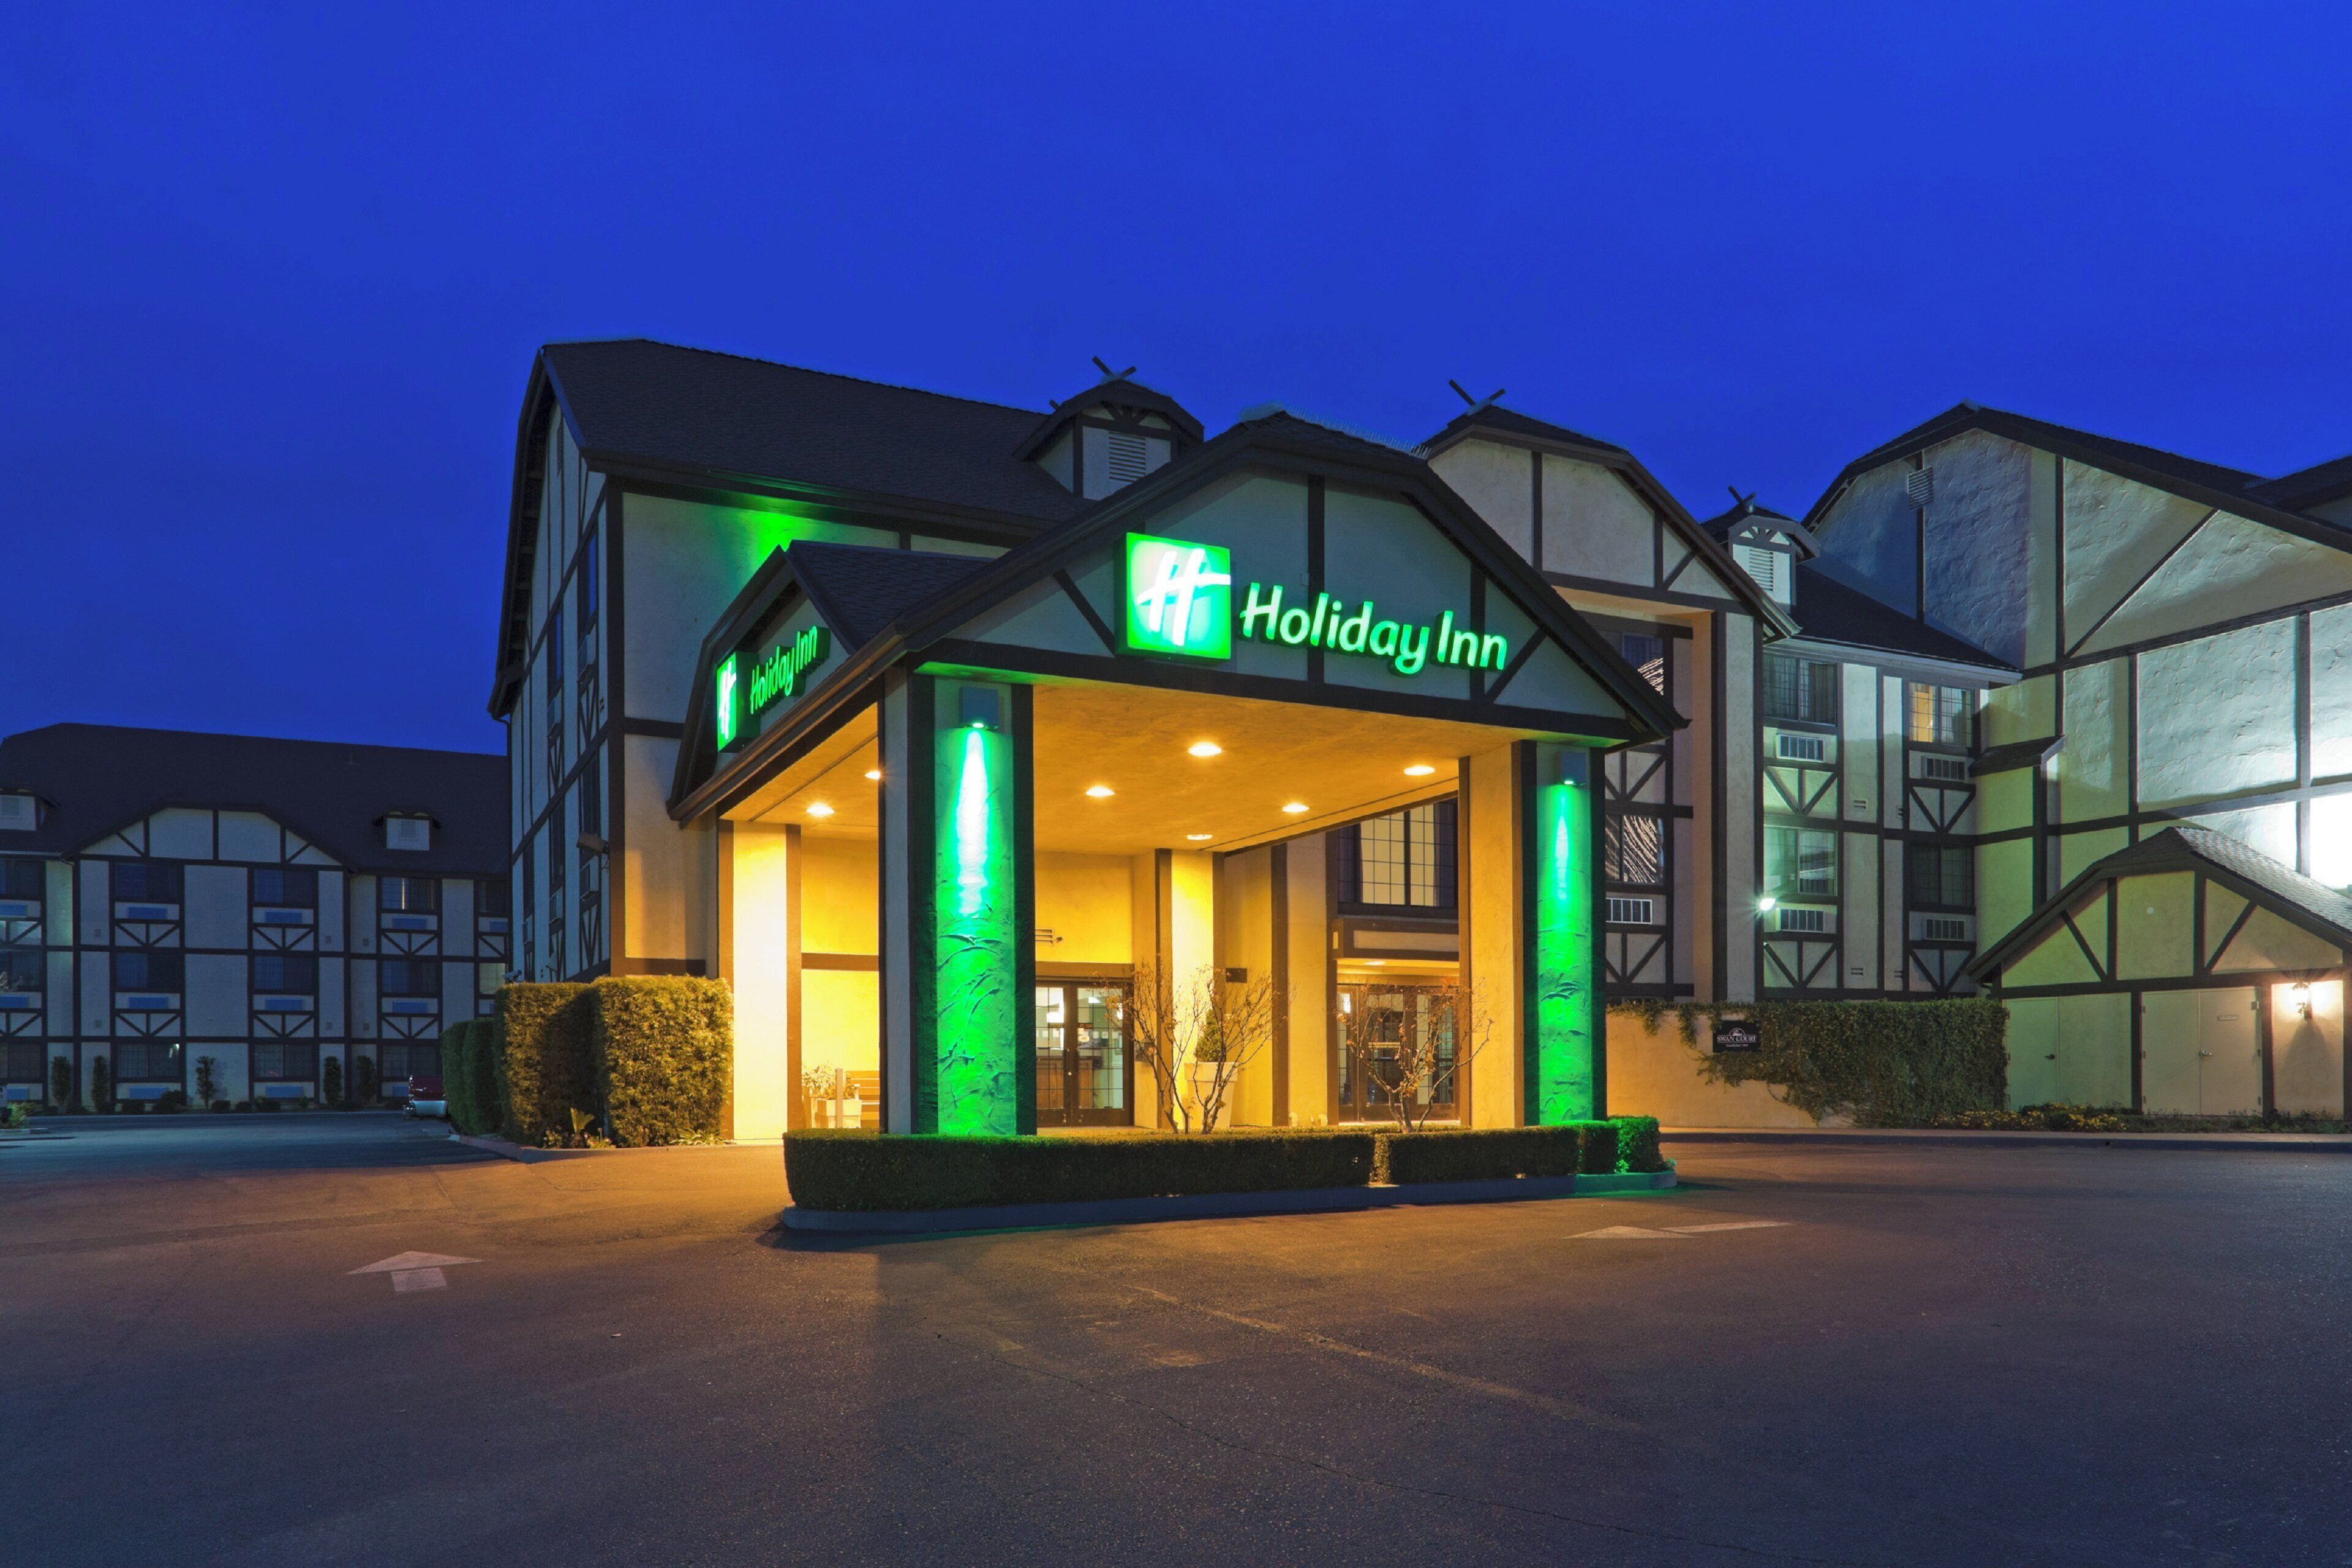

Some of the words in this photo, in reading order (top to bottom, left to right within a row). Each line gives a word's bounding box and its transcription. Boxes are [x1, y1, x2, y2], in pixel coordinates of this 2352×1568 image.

[750, 646, 795, 714] Holiday
[796, 625, 818, 674] Inn
[1240, 582, 1430, 674] Holiday
[1437, 611, 1507, 670] Inn
